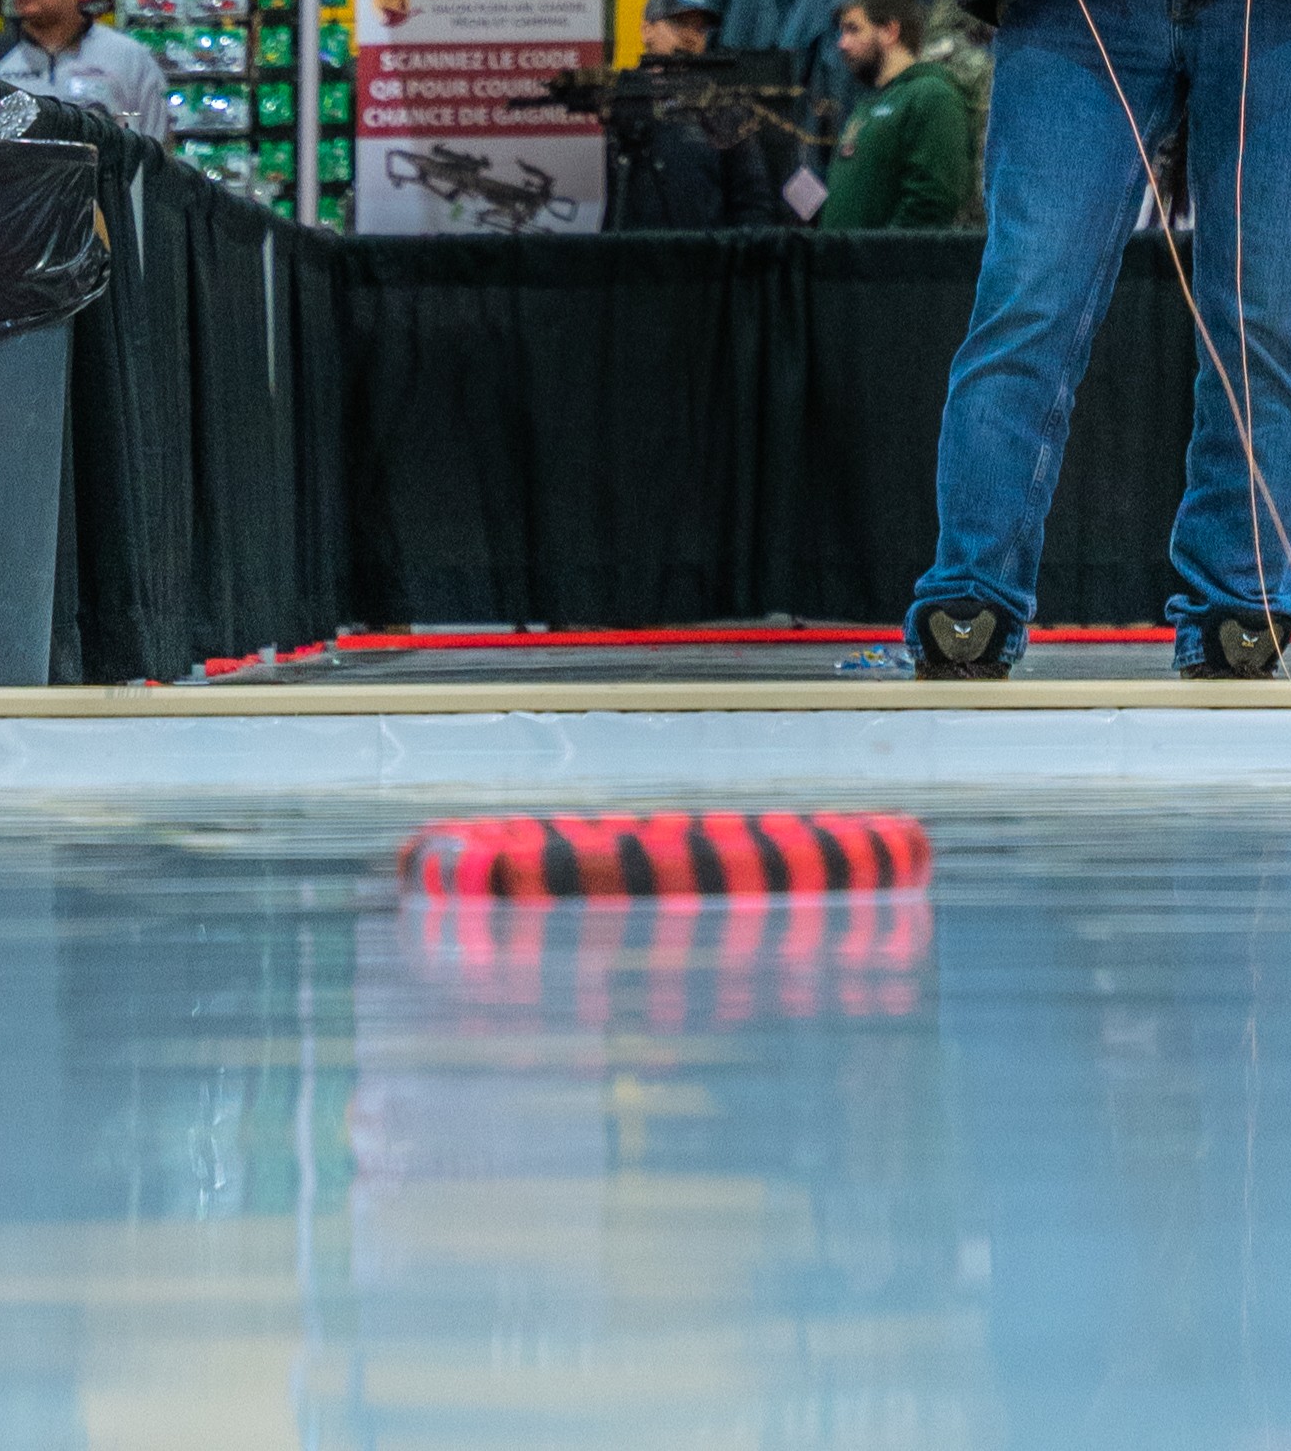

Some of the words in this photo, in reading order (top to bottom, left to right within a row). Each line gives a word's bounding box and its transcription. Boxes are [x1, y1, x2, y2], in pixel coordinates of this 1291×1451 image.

[379, 50, 486, 71] SCANNEZ
[488, 50, 515, 69] LE
[517, 50, 579, 69] CODE
[406, 79, 470, 98] POUR
[363, 106, 456, 126] CHANCE
